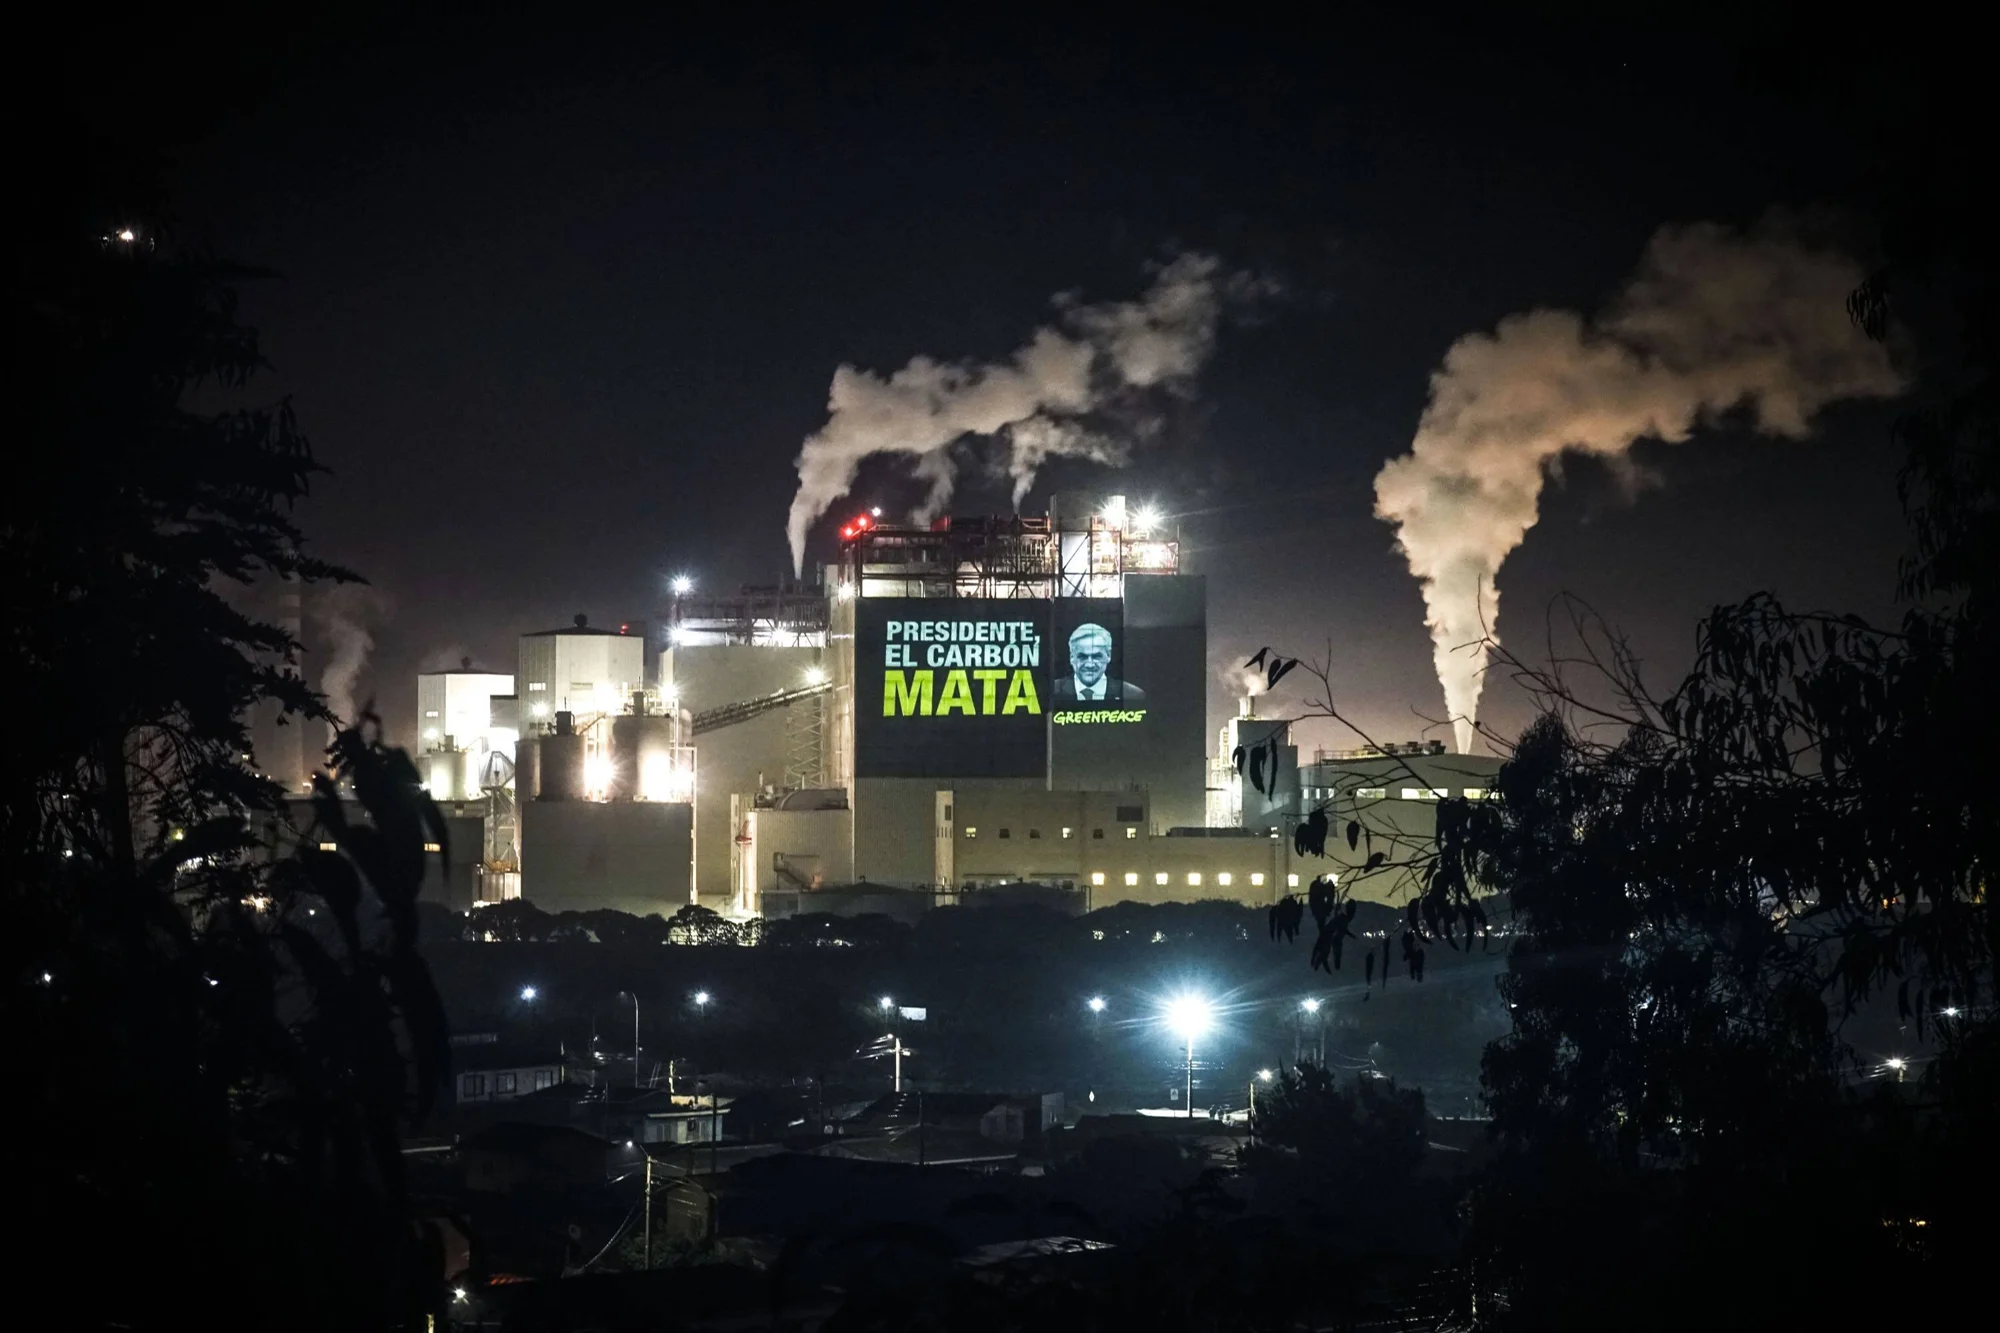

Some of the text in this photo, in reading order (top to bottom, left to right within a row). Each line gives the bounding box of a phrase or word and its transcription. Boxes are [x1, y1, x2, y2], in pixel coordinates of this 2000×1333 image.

[885, 640, 1040, 667] EL CARBÓN
[882, 669, 1042, 717] MATA
[1053, 709, 1147, 726] GREENPEACE
